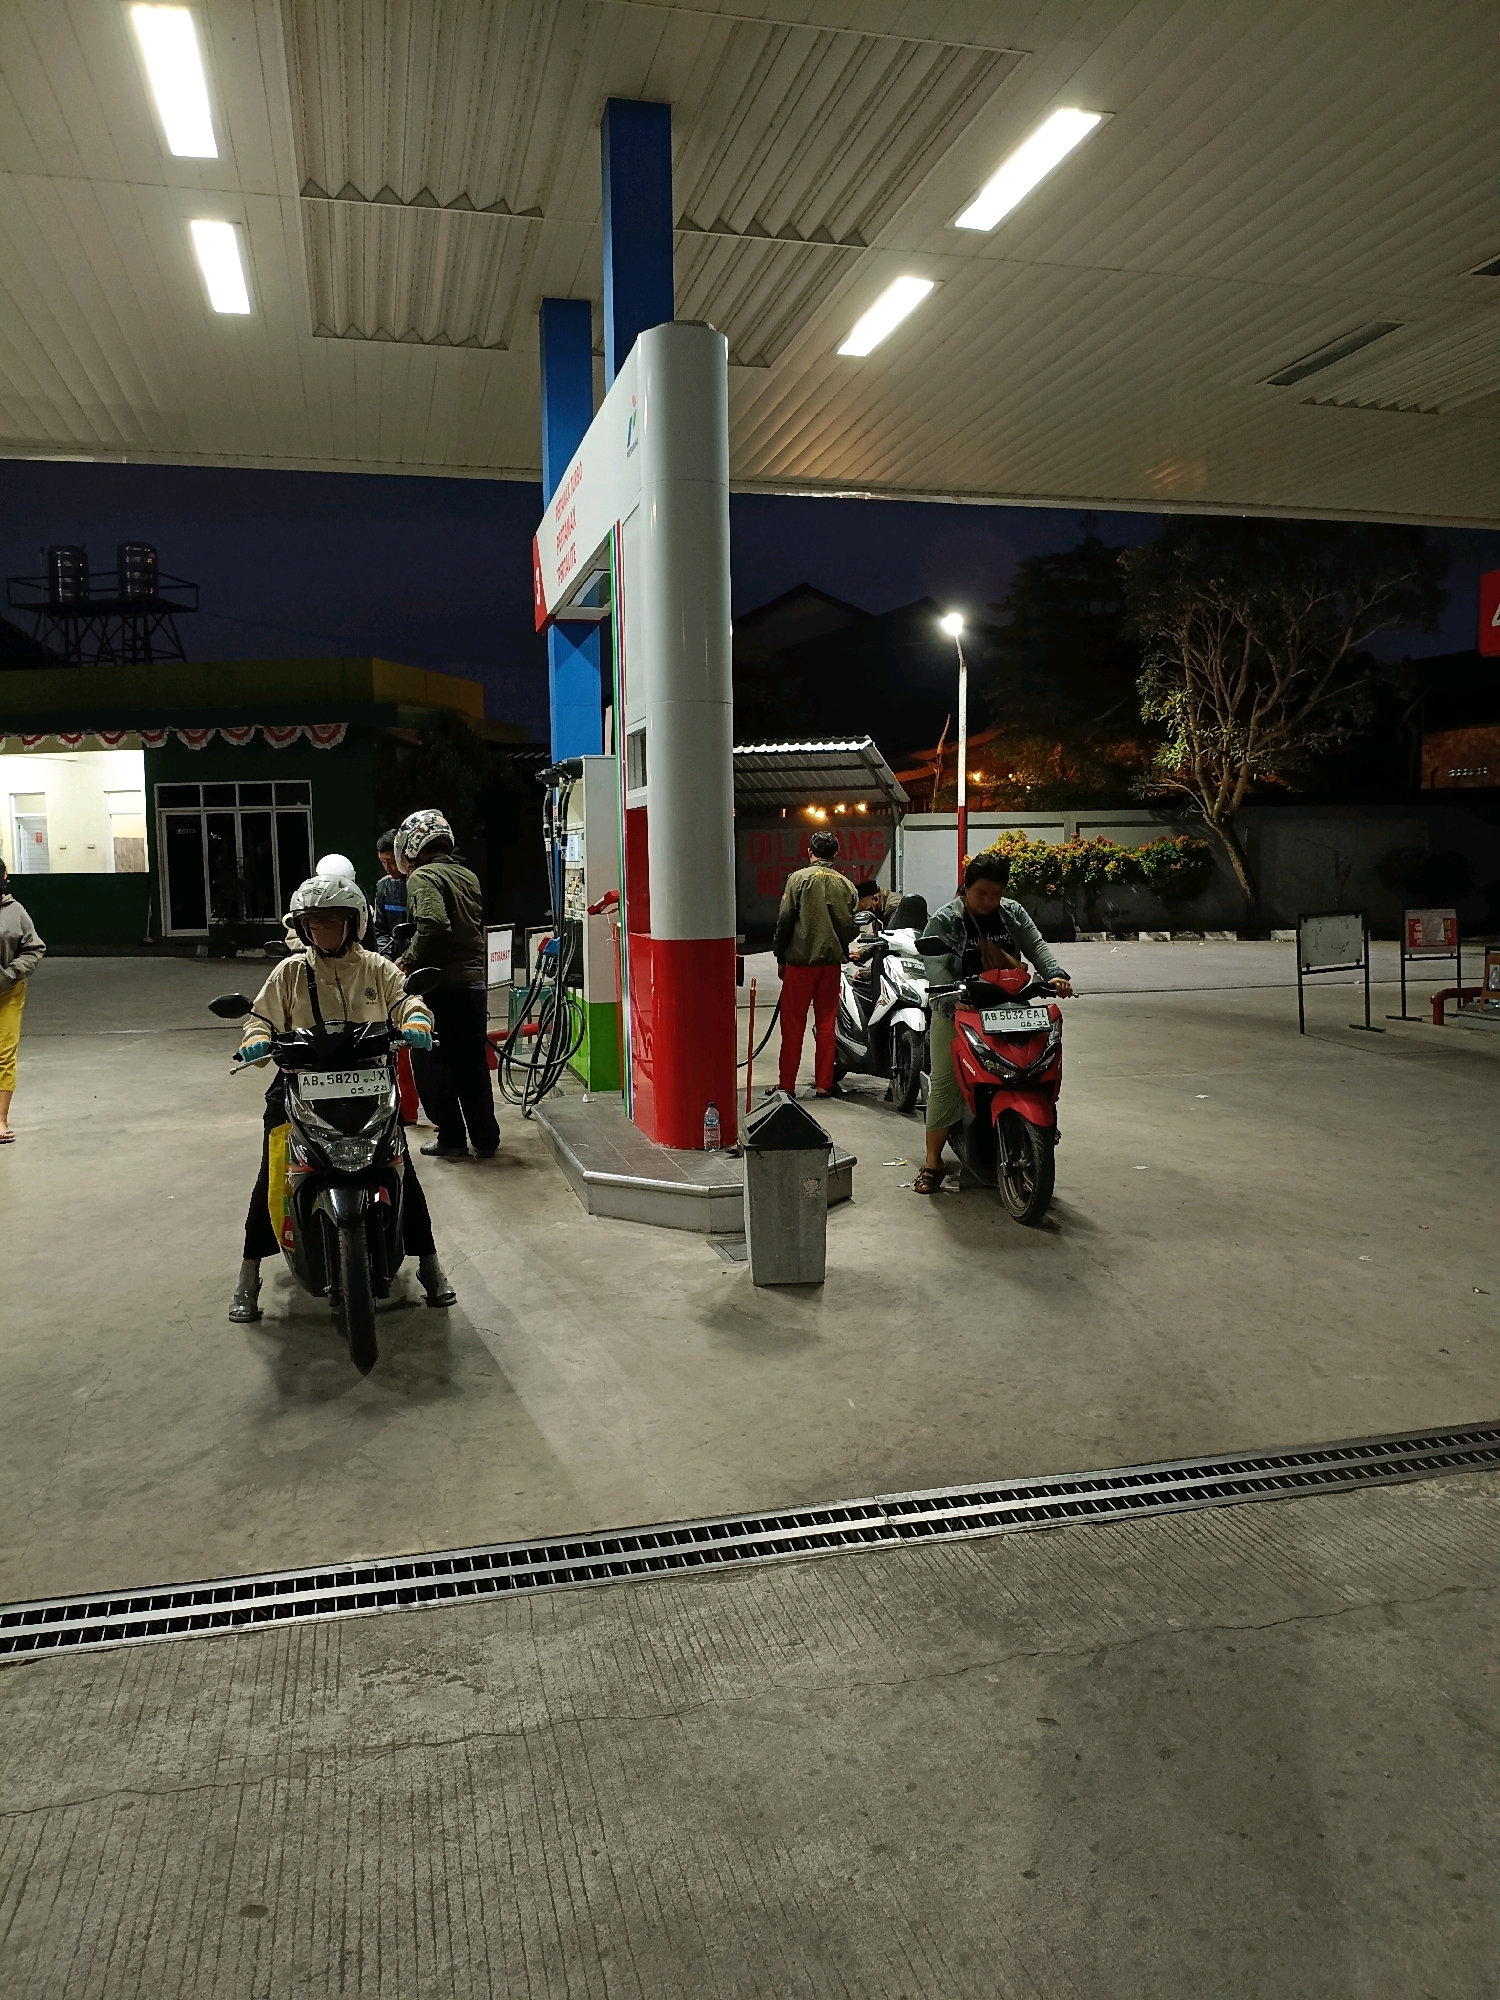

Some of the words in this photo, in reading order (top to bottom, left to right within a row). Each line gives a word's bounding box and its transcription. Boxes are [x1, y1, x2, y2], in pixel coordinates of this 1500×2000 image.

[557, 505, 576, 556] PERTAMAX
[535, 567, 541, 606] 3
[777, 830, 886, 862] LAANG
[491, 950, 510, 963] ISTIRAHAT
[985, 1013, 997, 1021] AB
[326, 1073, 360, 1085] 5820
